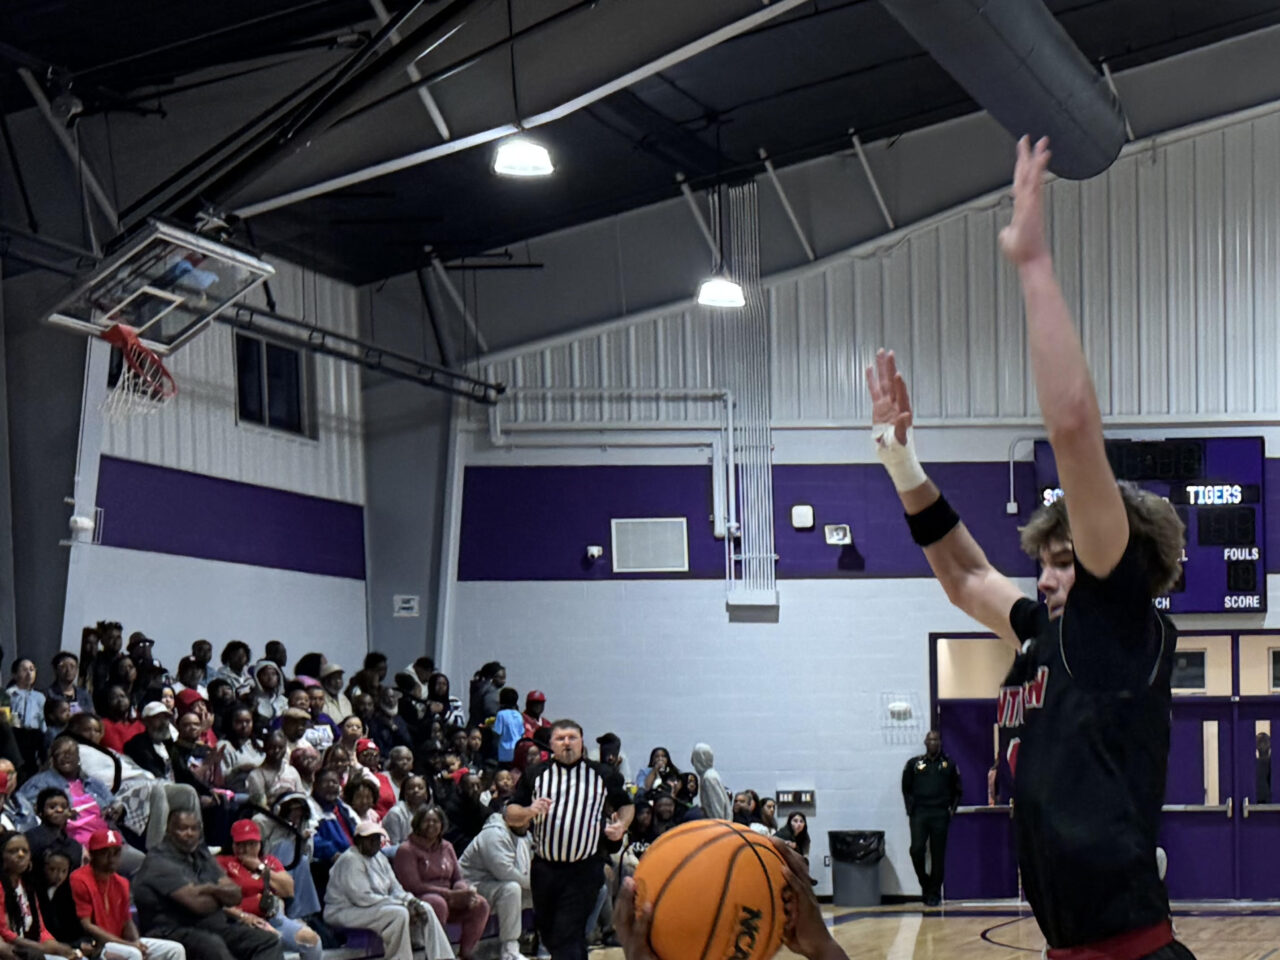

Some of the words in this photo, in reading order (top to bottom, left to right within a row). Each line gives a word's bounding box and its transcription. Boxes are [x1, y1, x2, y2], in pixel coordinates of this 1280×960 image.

[1186, 485, 1242, 504] TIGERS
[1224, 547, 1259, 561] FOULS
[1224, 595, 1260, 608] SCORE
